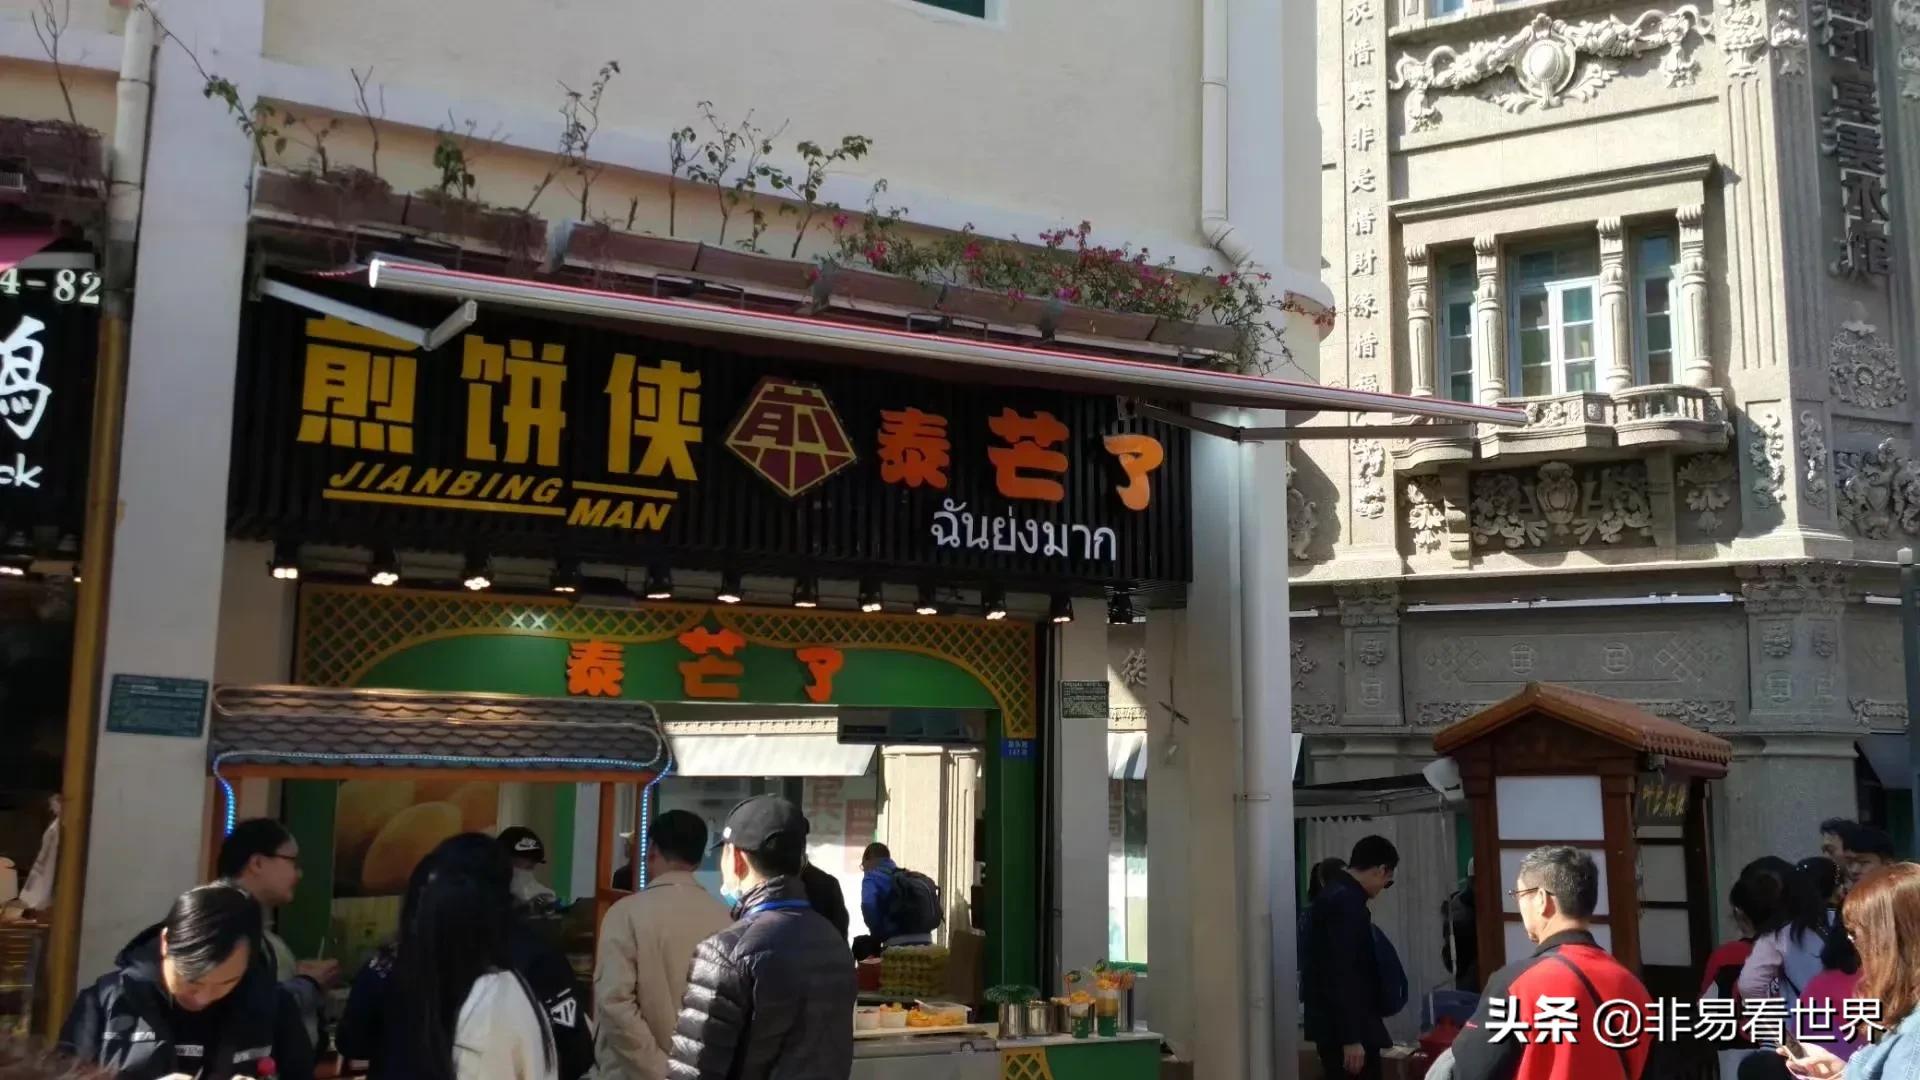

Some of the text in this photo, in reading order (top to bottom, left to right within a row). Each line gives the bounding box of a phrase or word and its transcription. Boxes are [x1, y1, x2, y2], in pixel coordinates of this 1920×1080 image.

[297, 313, 704, 482] 煎饼侠
[331, 460, 563, 505] JIANBING
[877, 407, 1164, 511] 泰芒了
[567, 496, 671, 532] MAN
[565, 627, 844, 703] 泰芒了
